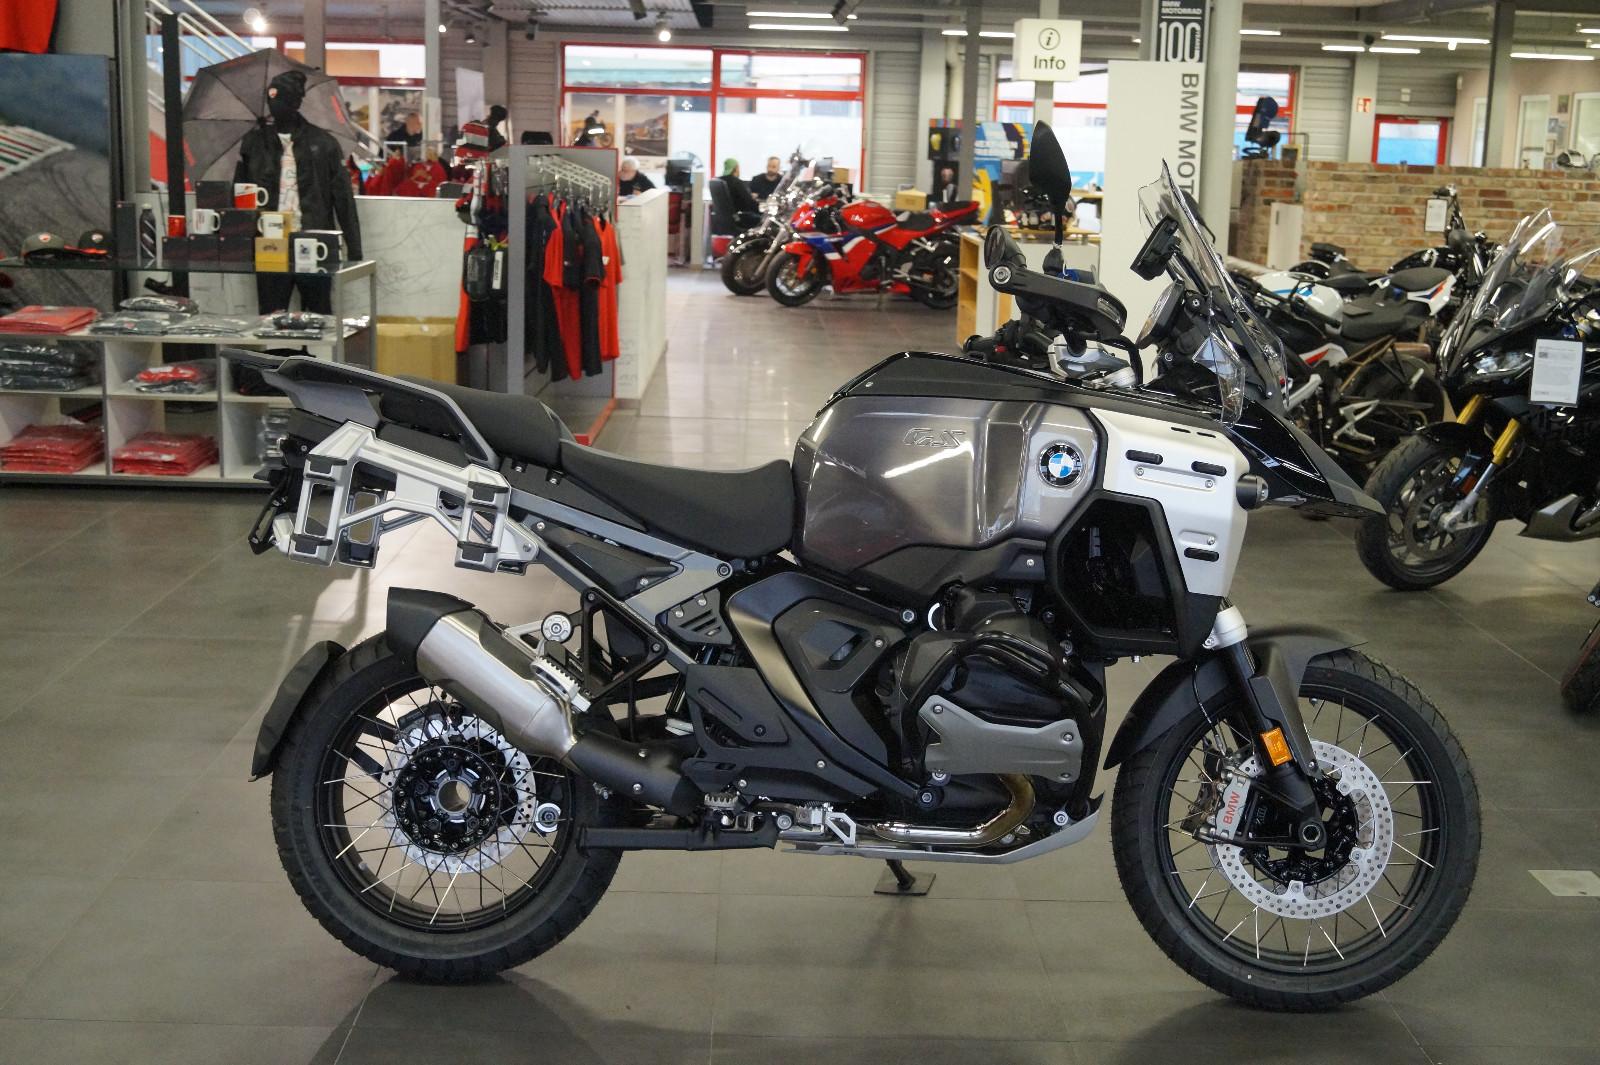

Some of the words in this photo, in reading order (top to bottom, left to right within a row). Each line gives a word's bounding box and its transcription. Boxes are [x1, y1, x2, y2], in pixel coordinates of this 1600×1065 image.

[1159, 21, 1202, 62] 100
[1033, 55, 1066, 70] Info
[1180, 73, 1200, 133] BMW
[1223, 790, 1241, 825] BMW
